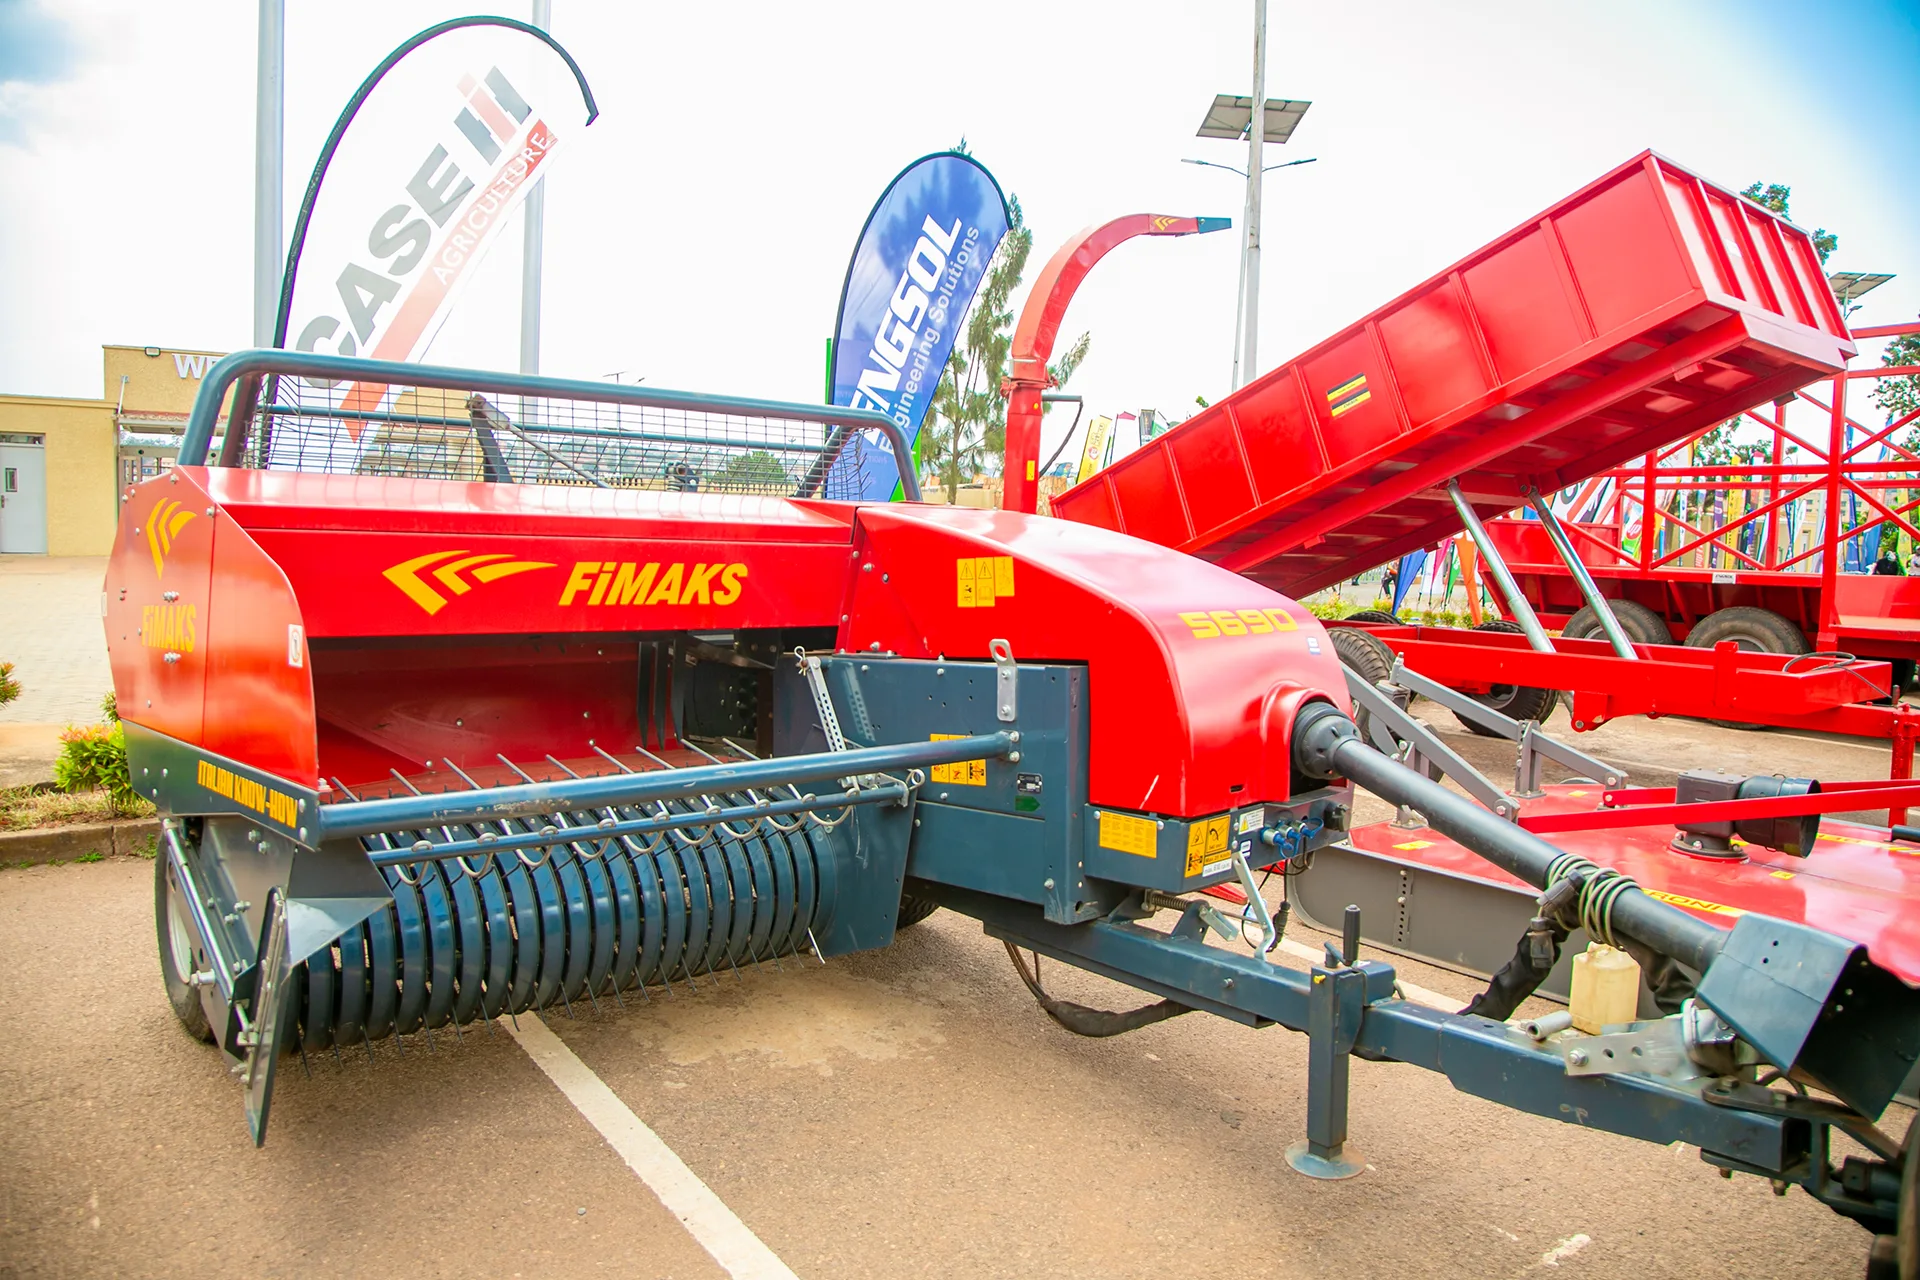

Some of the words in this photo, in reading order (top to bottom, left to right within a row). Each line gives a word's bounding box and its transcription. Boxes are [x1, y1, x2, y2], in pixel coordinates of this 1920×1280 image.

[433, 132, 550, 285] AGRICULTURE
[296, 143, 475, 389] CASE
[879, 327, 941, 456] Egineering
[928, 226, 979, 324] Solutions
[558, 561, 748, 606] FiMAKS
[141, 603, 197, 653] FiMAKS
[1177, 608, 1299, 639] 5690
[197, 759, 234, 799] ITALIAN
[234, 774, 298, 829] KNOW-HOW
